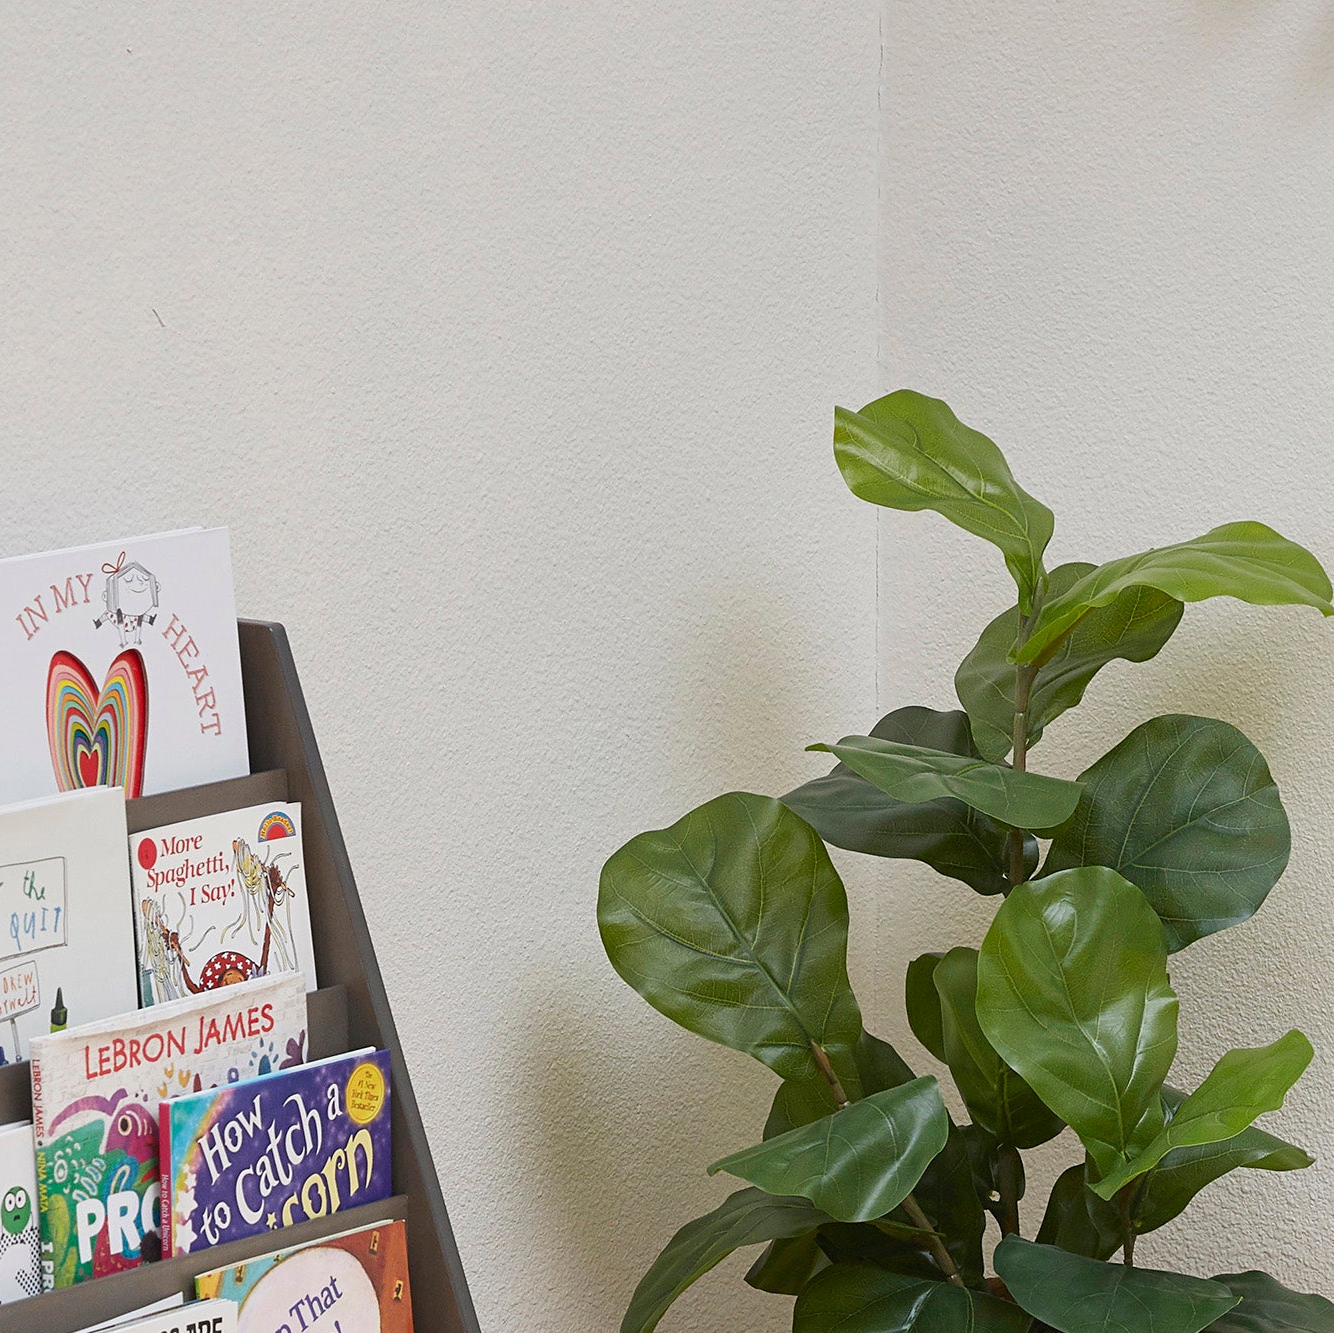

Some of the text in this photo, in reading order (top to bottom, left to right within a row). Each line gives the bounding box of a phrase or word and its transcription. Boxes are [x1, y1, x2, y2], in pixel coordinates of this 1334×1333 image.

[15, 573, 222, 737] IN MY HEART
[146, 851, 231, 893] Spaghetti,
[159, 834, 204, 859] More
[23, 869, 47, 901] the
[189, 878, 236, 906] I Say!
[10, 906, 63, 952] QUIT
[193, 1003, 276, 1055] JAMES
[31, 1059, 45, 1138] LEBRON JAMES
[197, 1083, 343, 1187] How a
[37, 1151, 49, 1213] NINA MATA
[199, 1093, 323, 1246] to Catch
[288, 1274, 344, 1330] That
